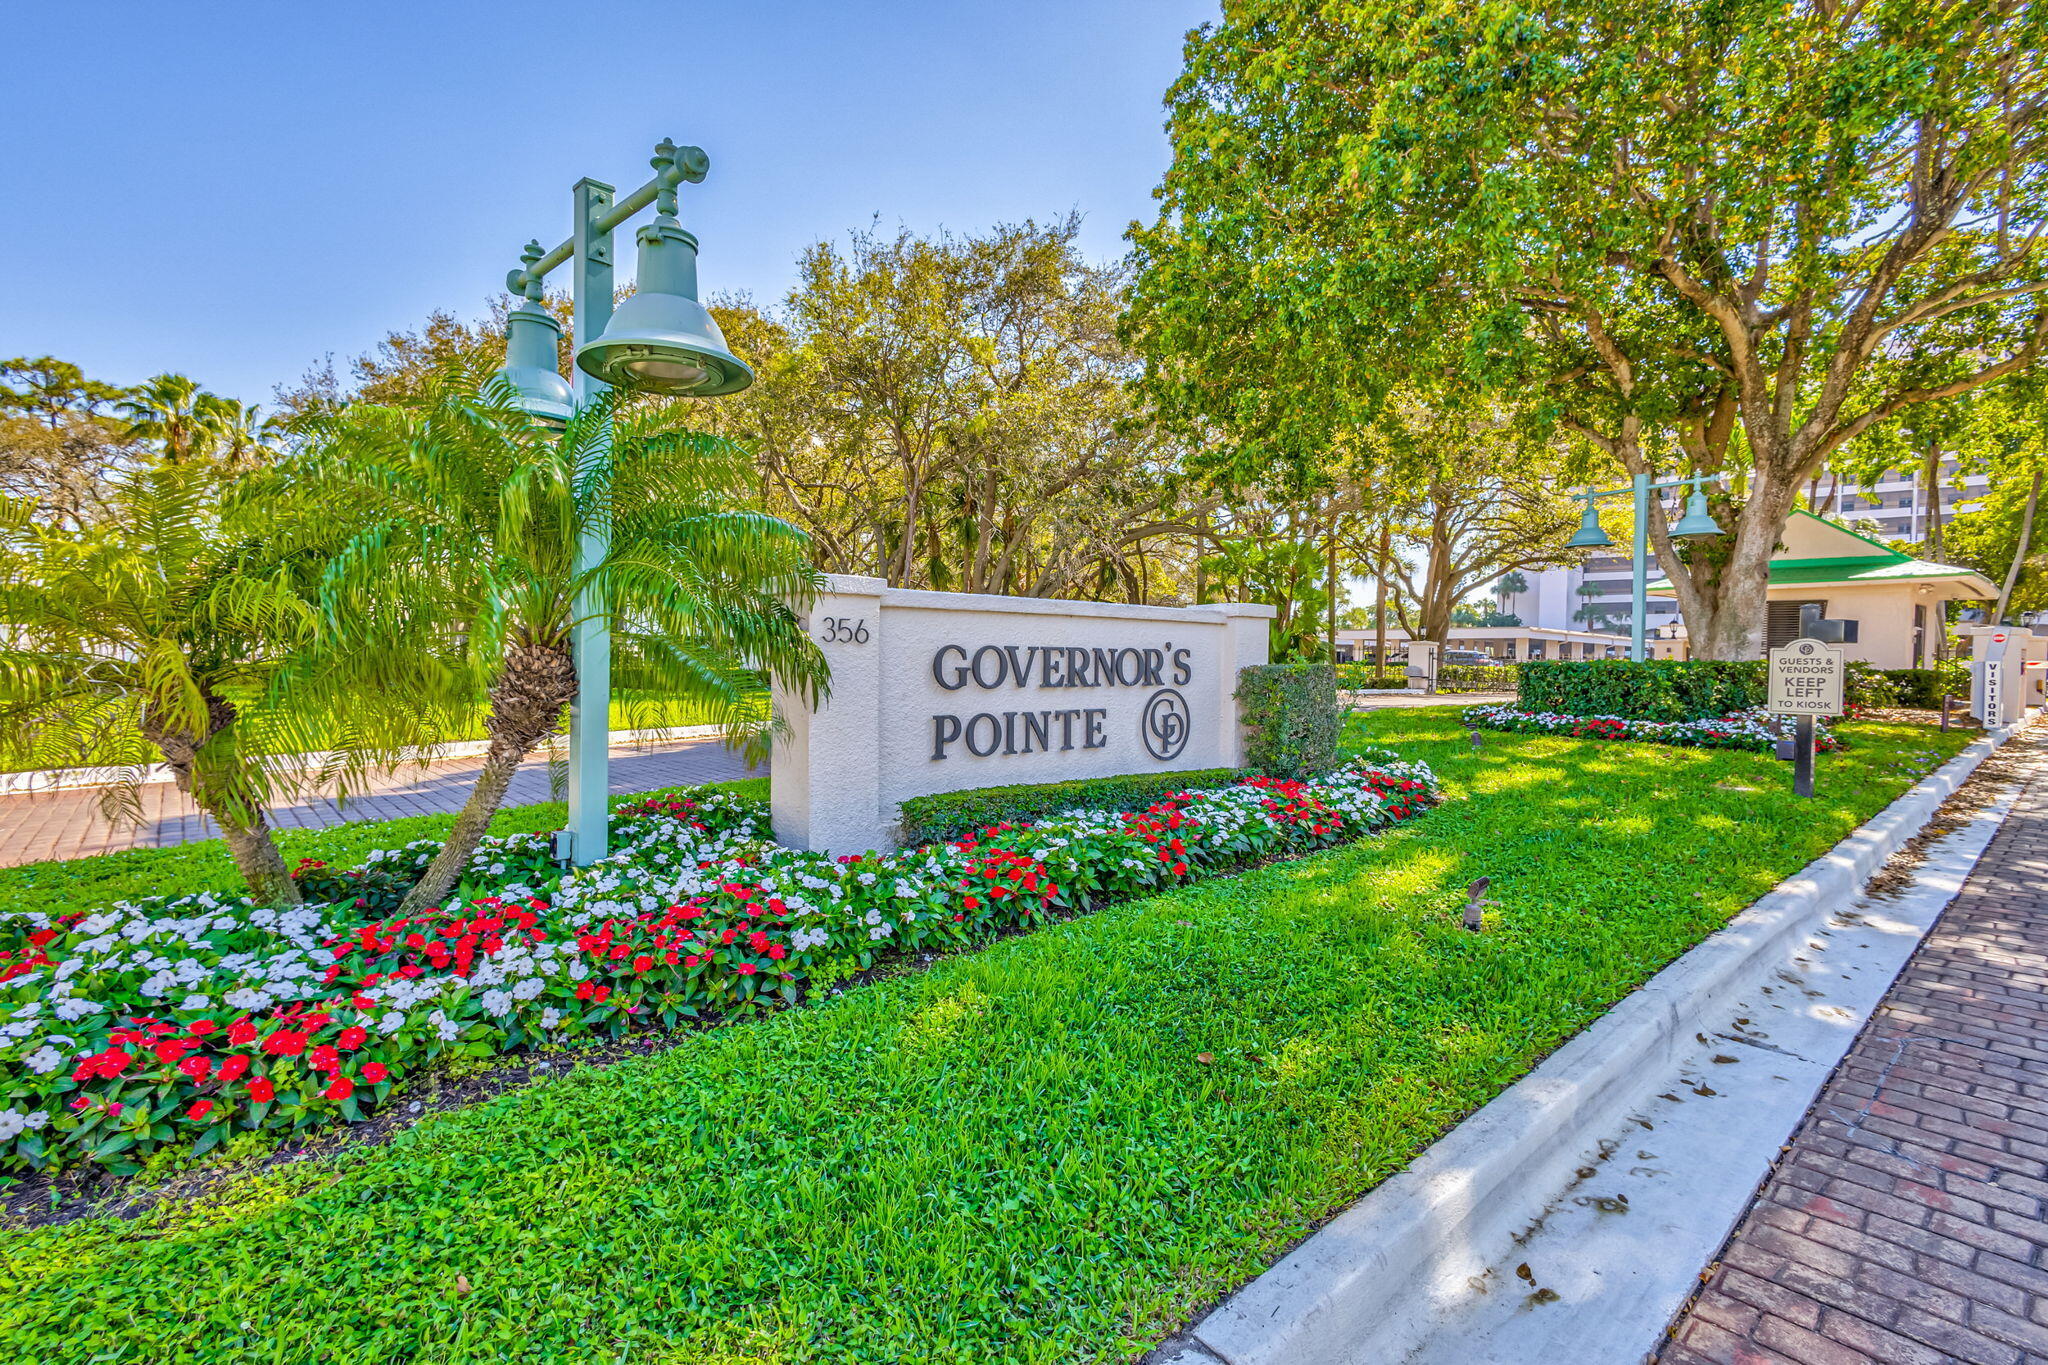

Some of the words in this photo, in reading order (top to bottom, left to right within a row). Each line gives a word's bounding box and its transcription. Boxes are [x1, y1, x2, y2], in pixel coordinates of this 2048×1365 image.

[821, 616, 870, 645] 356
[932, 641, 1192, 691] GOVERNOR'S
[1779, 657, 1822, 665] GUESTS
[1779, 666, 1834, 674] VENDORS
[1785, 677, 1826, 687] KEEP
[1786, 688, 1823, 698] LEFT
[1987, 663, 1997, 725] VISITORS
[1778, 700, 1793, 708] TO
[1796, 701, 1832, 709] KIOSK
[930, 708, 1108, 761] POINTE
